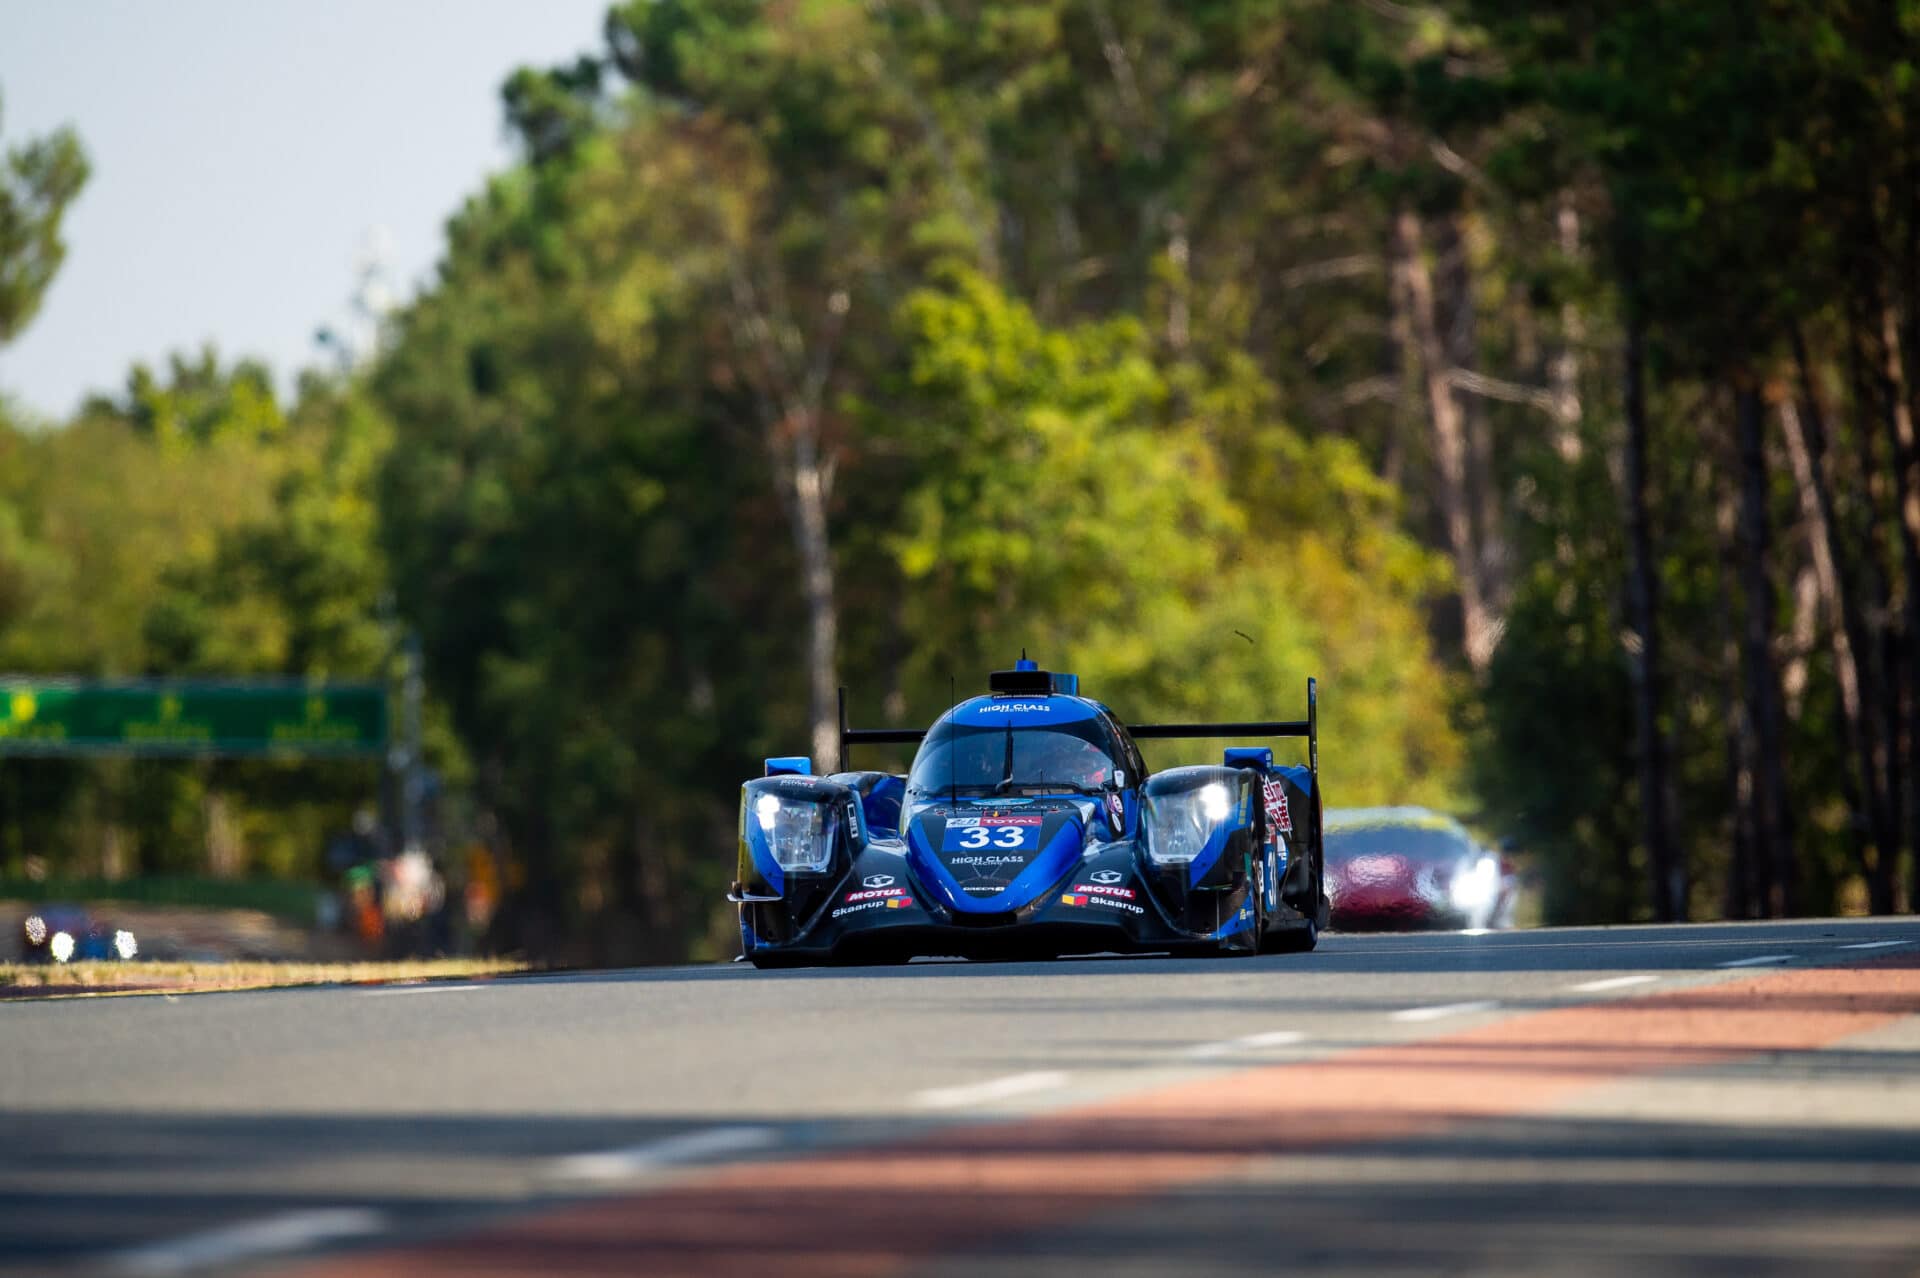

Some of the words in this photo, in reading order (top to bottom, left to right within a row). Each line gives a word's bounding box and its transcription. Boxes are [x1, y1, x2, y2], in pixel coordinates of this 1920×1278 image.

[980, 705, 1010, 713] HIGH
[1013, 704, 1051, 712] CLASS
[959, 825, 1025, 848] 33
[951, 856, 982, 864] HIGH
[986, 855, 1024, 863] CLASS
[848, 888, 904, 901] MOTUL
[1077, 885, 1133, 898] MOTUL
[831, 901, 884, 918] Skaarup
[1090, 896, 1144, 914] Skaarup
